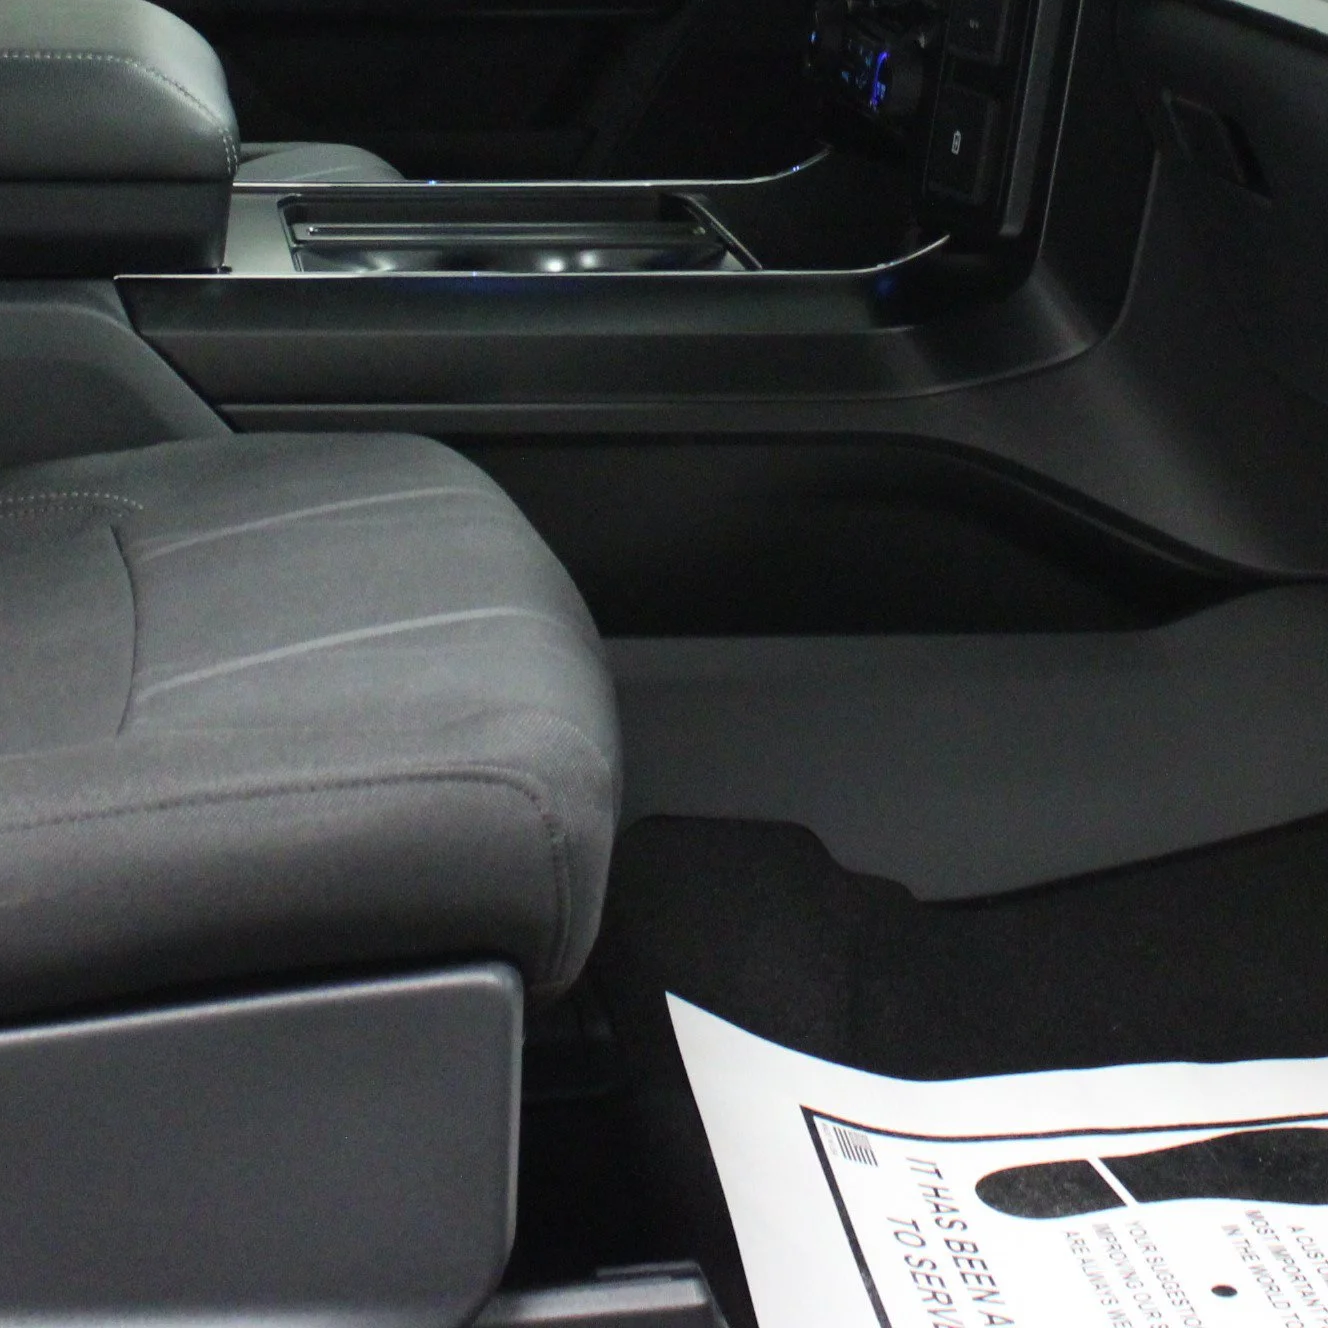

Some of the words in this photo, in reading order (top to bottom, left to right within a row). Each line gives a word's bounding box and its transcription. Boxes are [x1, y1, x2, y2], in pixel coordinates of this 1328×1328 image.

[906, 1157, 943, 1180] IT
[886, 1217, 926, 1247] TO
[918, 1183, 968, 1232] HAS
[1286, 1224, 1305, 1233] A
[944, 1237, 1006, 1305] BEEN
[1076, 1257, 1119, 1306] ALWAYS
[1092, 1223, 1144, 1289] IMPROVING
[1133, 1293, 1162, 1321] OUR
[1125, 1220, 1158, 1253] YOUR
[1146, 1255, 1203, 1328] SUGGESTIO
[1232, 1238, 1260, 1263] THE
[1249, 1264, 1291, 1309] WORLD
[1245, 1209, 1280, 1242] MOST
[1268, 1244, 1328, 1314] IMPORTANT
[978, 1309, 1015, 1327] A
